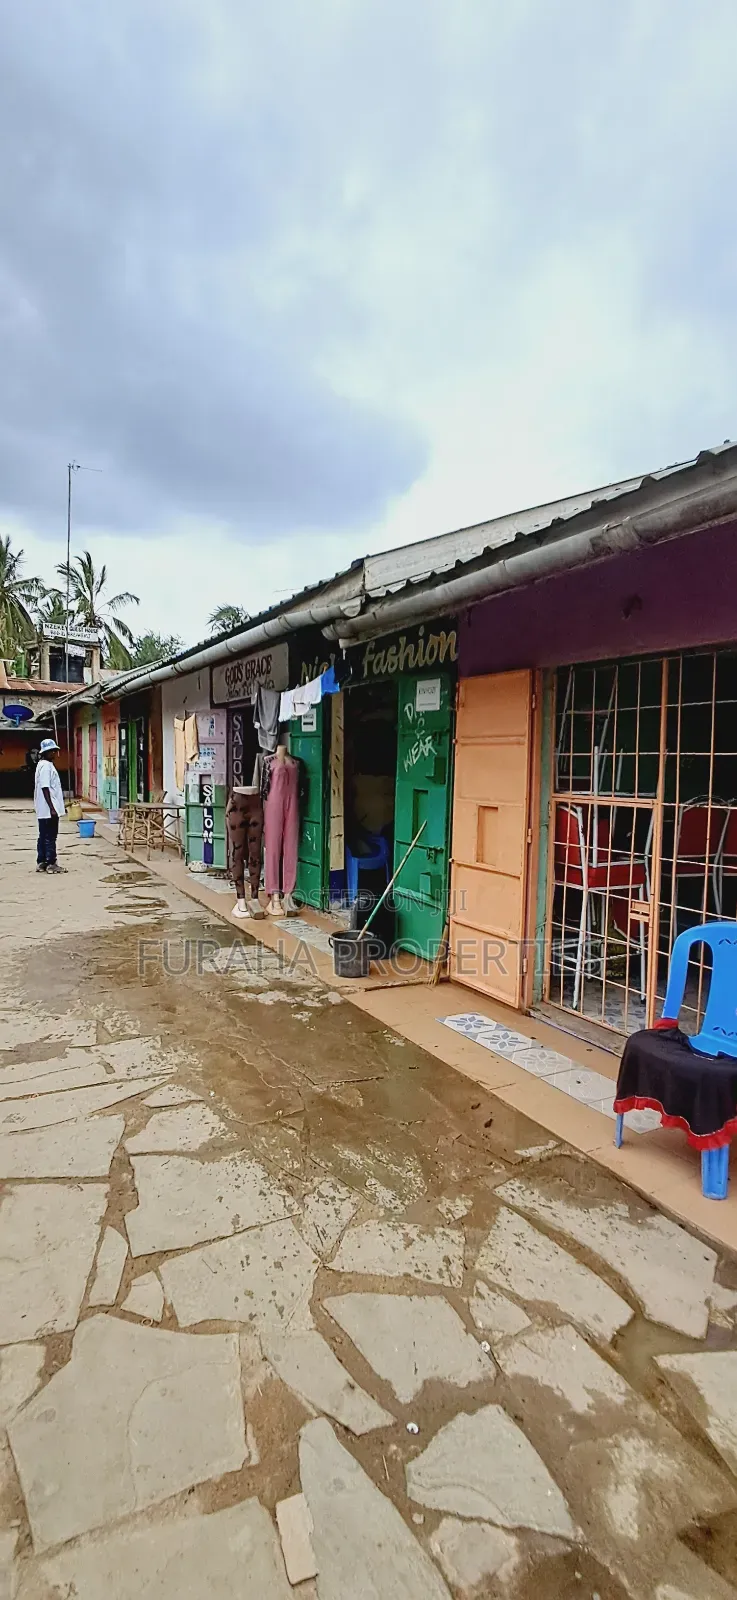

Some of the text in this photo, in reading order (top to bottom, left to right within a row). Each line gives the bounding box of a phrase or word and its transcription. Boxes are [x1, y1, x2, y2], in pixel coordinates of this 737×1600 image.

[245, 654, 273, 681] GRACE
[362, 625, 459, 678] fashion
[232, 714, 244, 787] SALON
[403, 735, 437, 773] WEAR
[202, 784, 214, 844] SALON
